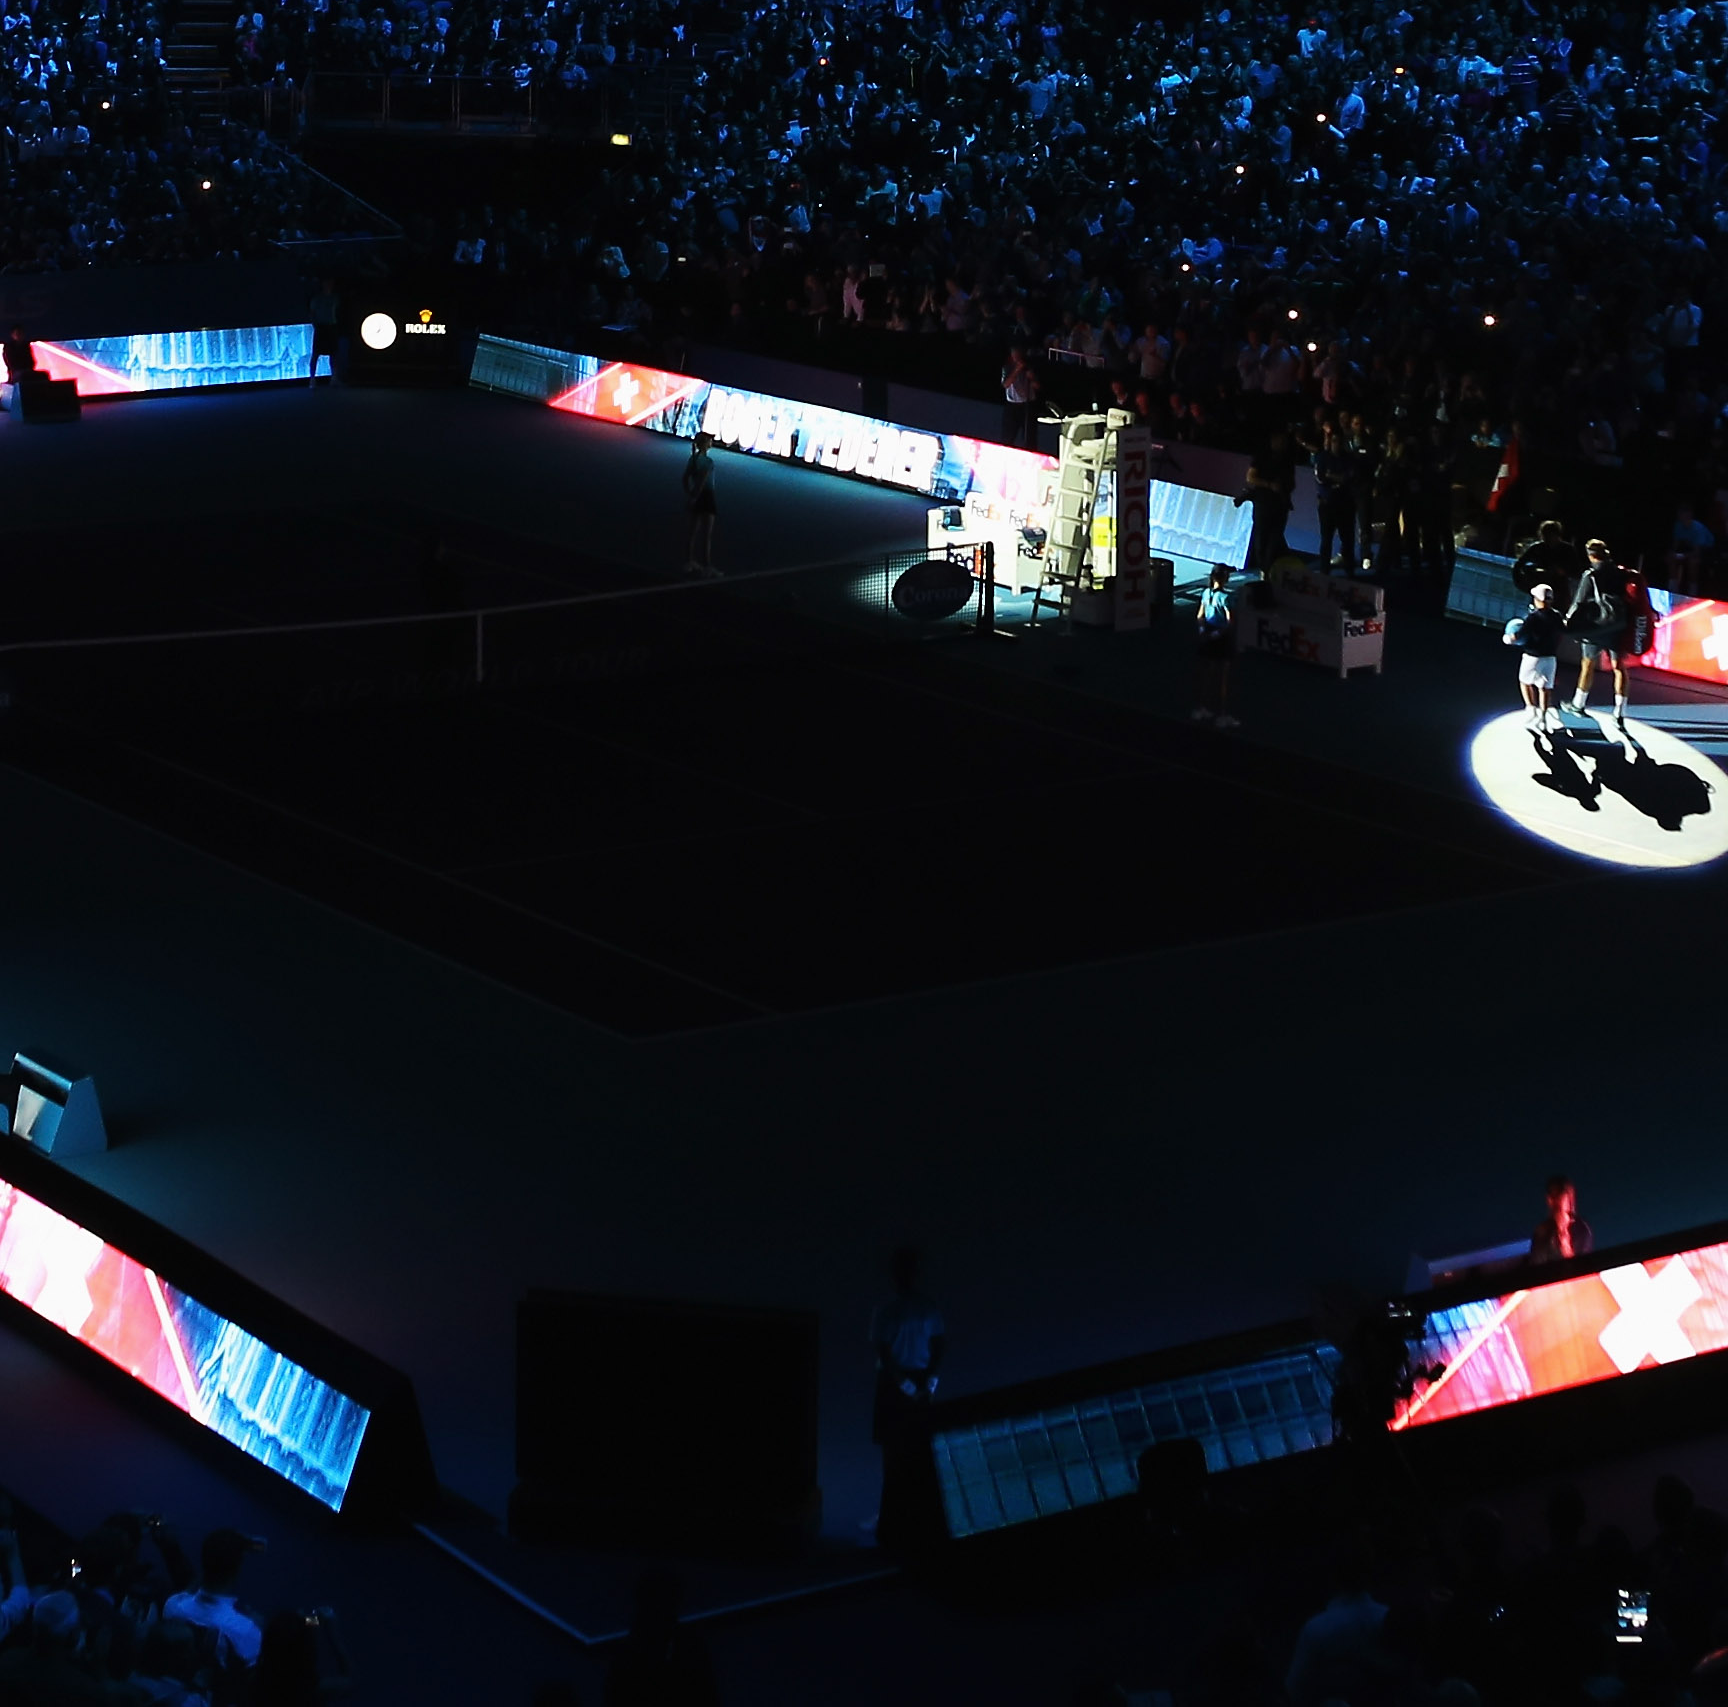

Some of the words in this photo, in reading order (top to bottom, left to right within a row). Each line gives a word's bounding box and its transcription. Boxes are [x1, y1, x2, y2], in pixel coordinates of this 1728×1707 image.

[405, 323, 446, 334] ROLEX
[702, 388, 797, 458] ROGER
[803, 411, 941, 491] FEDERER
[1124, 450, 1147, 601] RICOH
[1258, 618, 1320, 662] FedEx
[1344, 619, 1383, 637] FedEx
